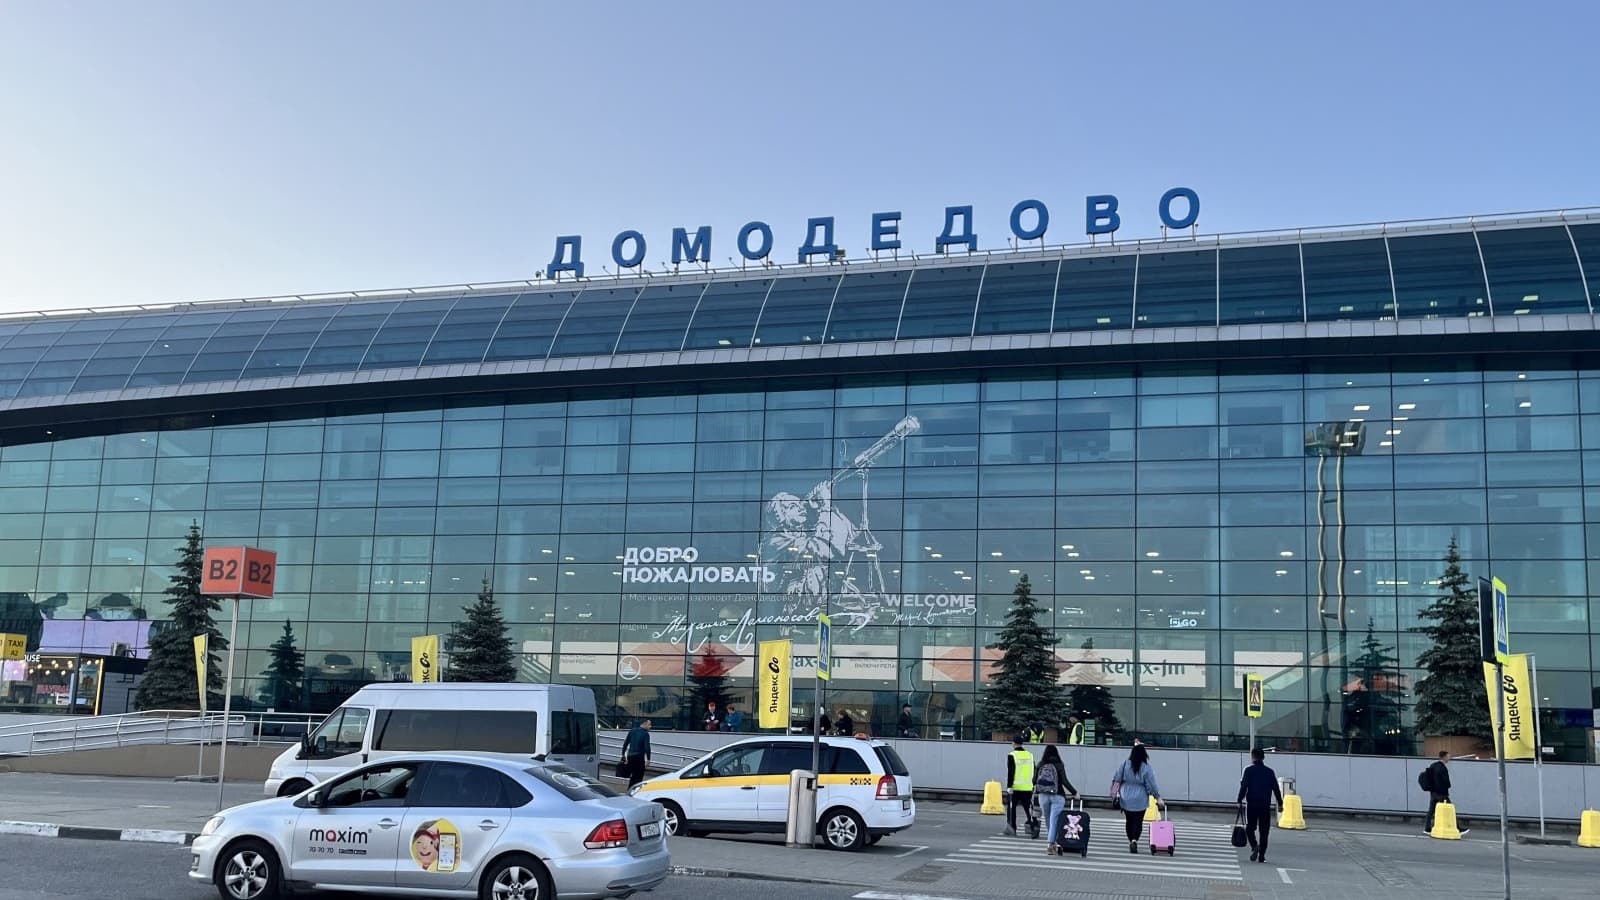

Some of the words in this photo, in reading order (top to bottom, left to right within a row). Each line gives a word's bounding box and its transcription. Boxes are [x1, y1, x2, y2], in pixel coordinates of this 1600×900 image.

[547, 187, 1200, 279] ДОМОДЕДОВО
[623, 547, 698, 566] ДОБРО
[210, 559, 238, 580] B2
[248, 561, 272, 585] B2
[622, 566, 776, 583] ПОЖАЛОВАТЬ
[885, 594, 976, 608] WELCOME
[768, 656, 780, 674] Go
[1100, 657, 1186, 678] Relx-fm
[769, 674, 779, 713] Яндекс
[1507, 695, 1520, 742] Яндекс
[309, 826, 368, 844] maxim
